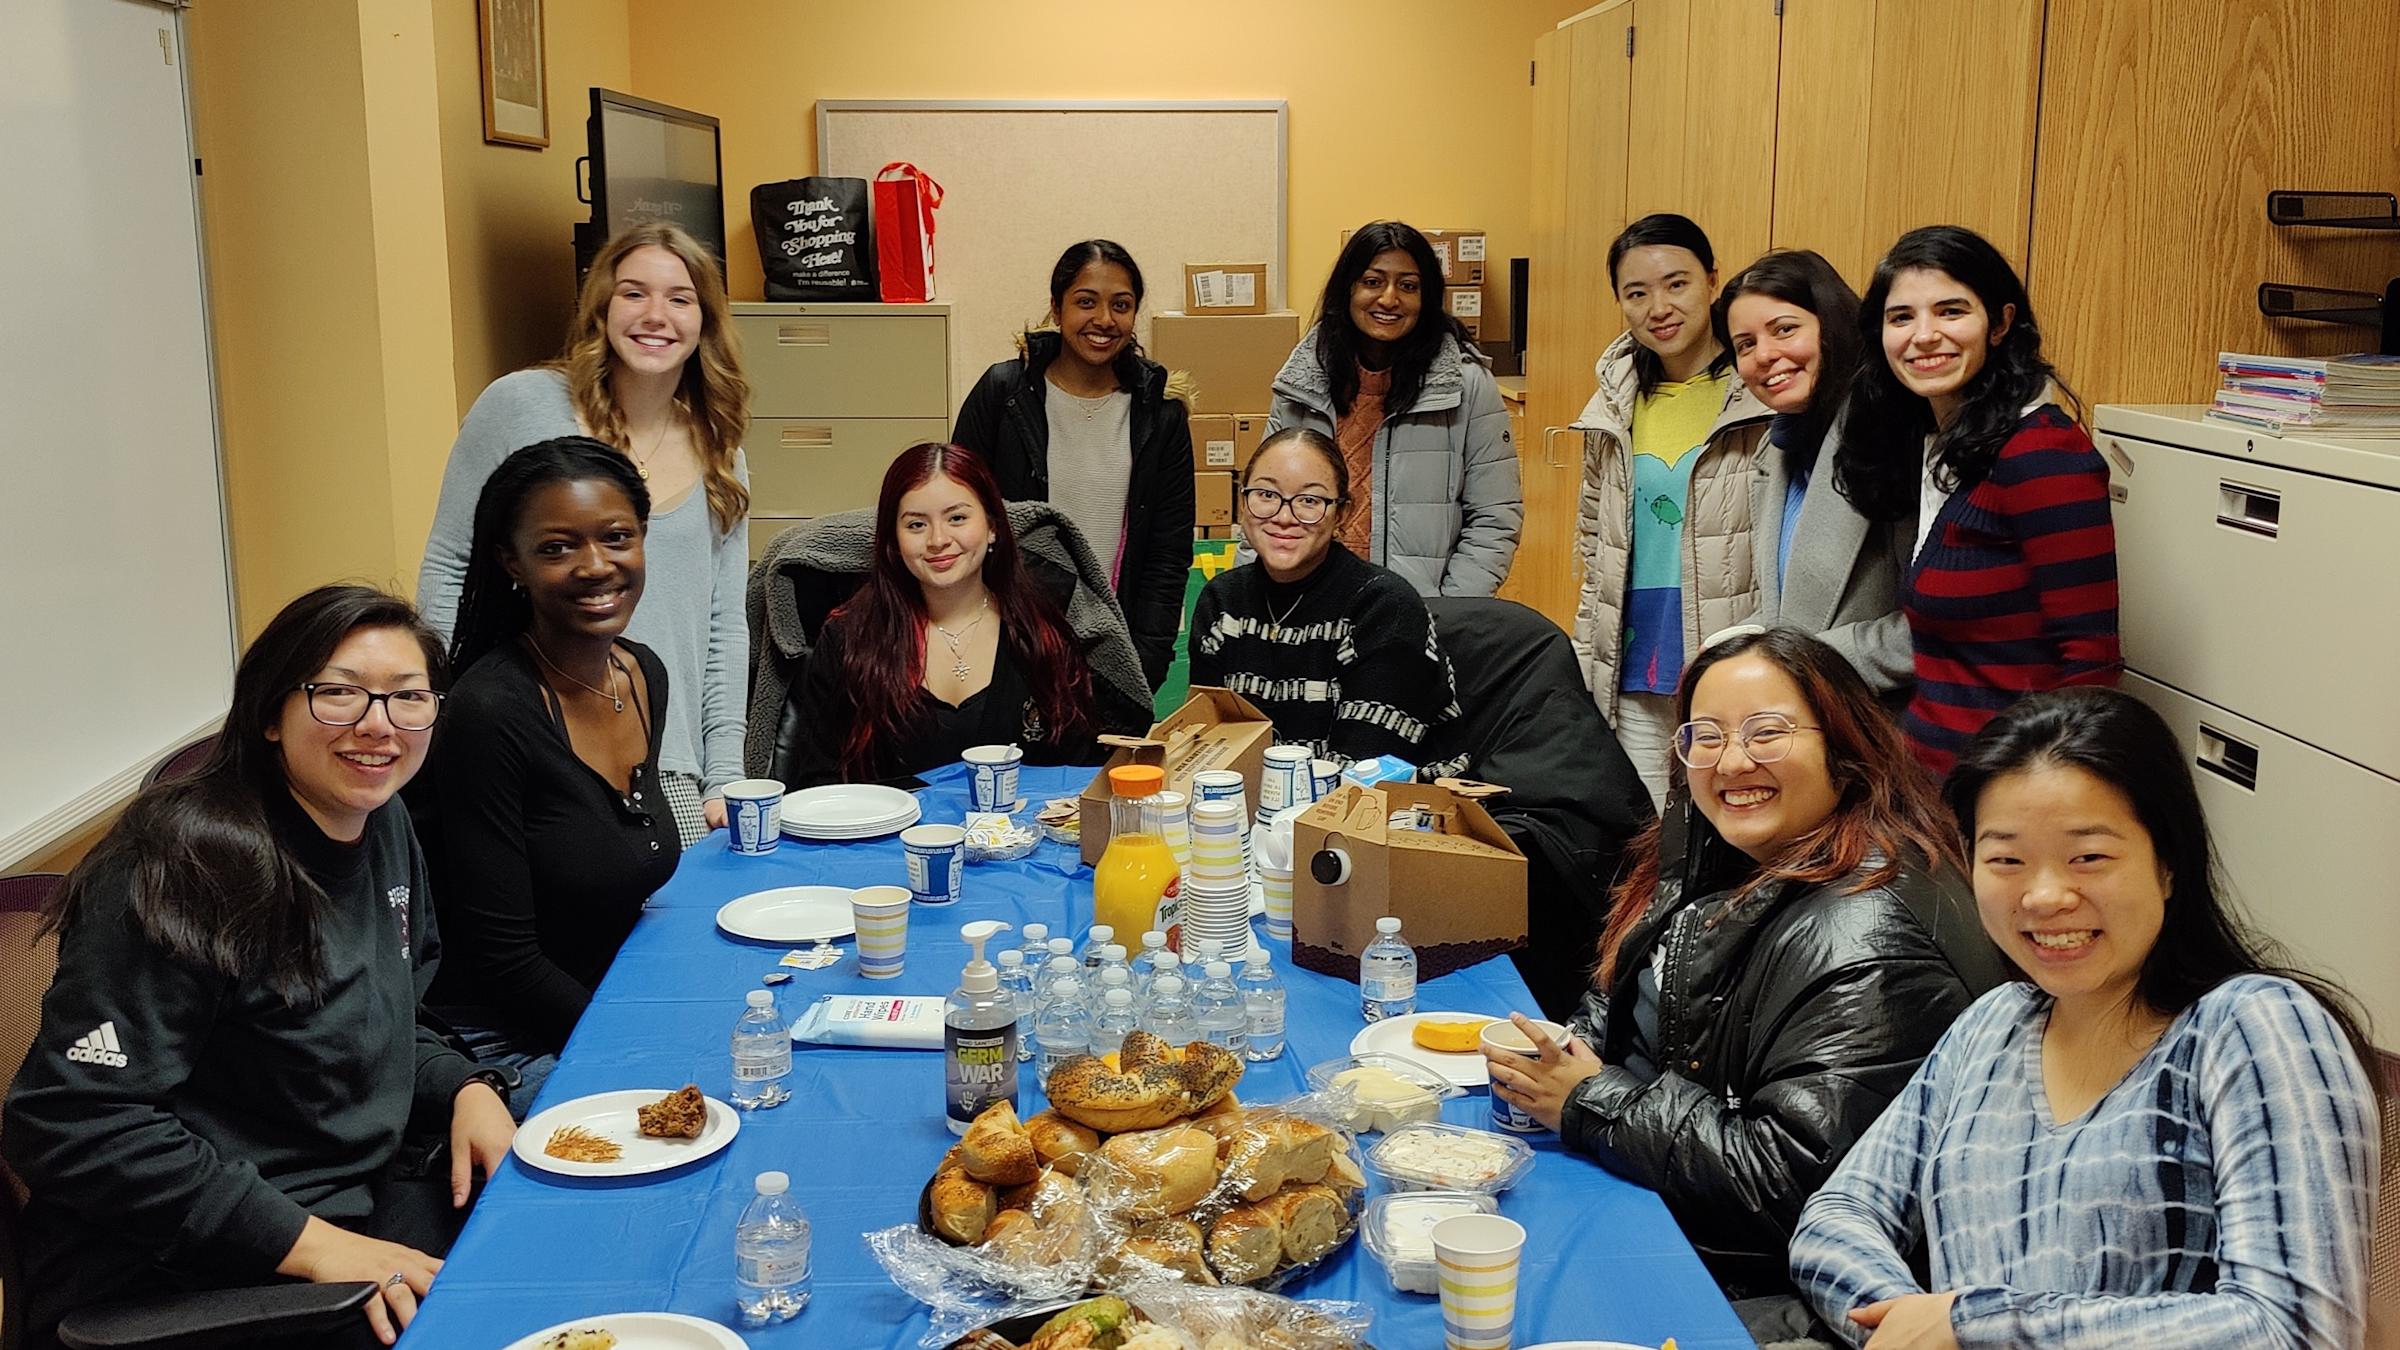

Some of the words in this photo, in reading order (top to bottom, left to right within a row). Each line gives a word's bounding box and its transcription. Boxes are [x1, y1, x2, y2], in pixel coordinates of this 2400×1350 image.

[787, 196, 840, 216] Thank
[784, 219, 817, 233] You
[812, 214, 843, 233] for
[781, 230, 856, 256] Shopping
[801, 249, 844, 268] Here!
[859, 1001, 876, 1019] Hand
[871, 1001, 889, 1020] Wipes
[66, 1047, 128, 1068] adidas
[957, 1046, 1004, 1065] GERM
[959, 1063, 1004, 1084] WAR
